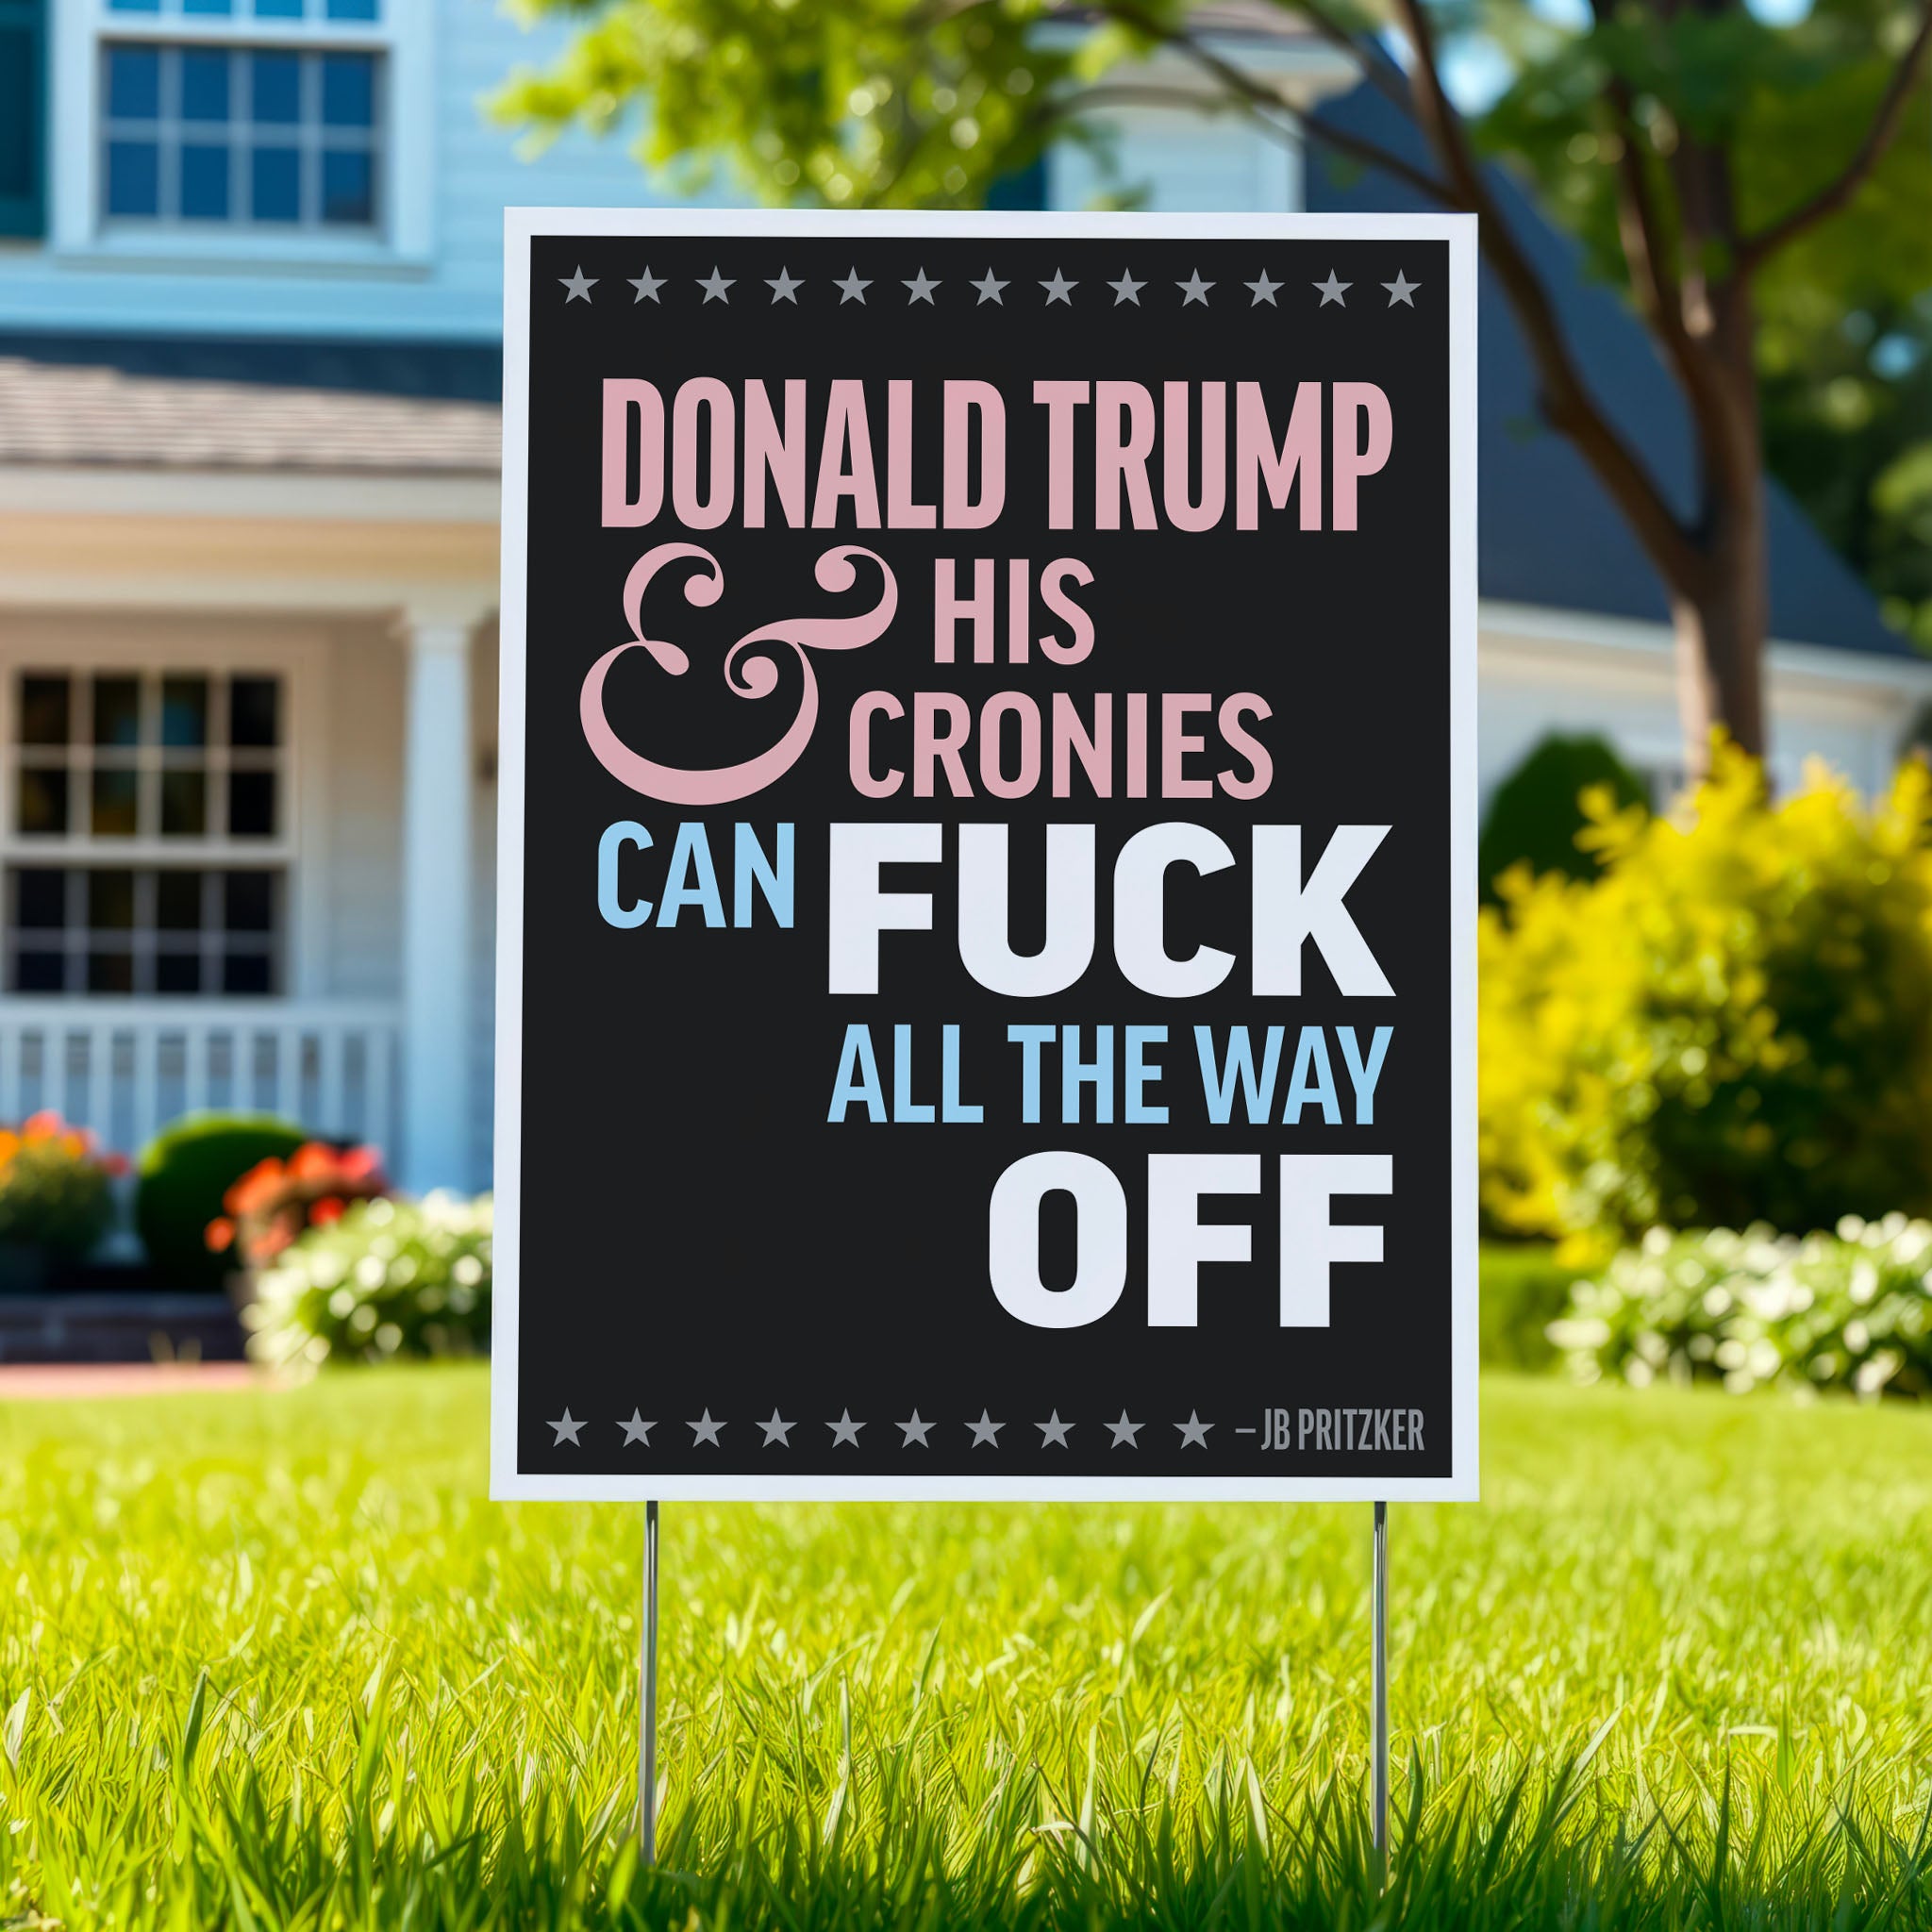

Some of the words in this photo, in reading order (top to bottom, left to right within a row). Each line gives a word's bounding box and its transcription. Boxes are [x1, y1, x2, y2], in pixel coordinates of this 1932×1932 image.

[601, 377, 1007, 531] DONALD
[1032, 381, 1393, 533] TRUMP
[579, 541, 899, 807] &
[934, 557, 1095, 666] HIS
[848, 690, 1274, 801] CRONIES
[596, 820, 795, 930] CAN
[827, 822, 1397, 999] FUCK
[826, 1024, 985, 1124] ALL
[1007, 1024, 1170, 1125] THE
[1192, 1024, 1395, 1125] WAY
[989, 1150, 1393, 1329] OFF
[1298, 1407, 1425, 1452] PRITZKER
